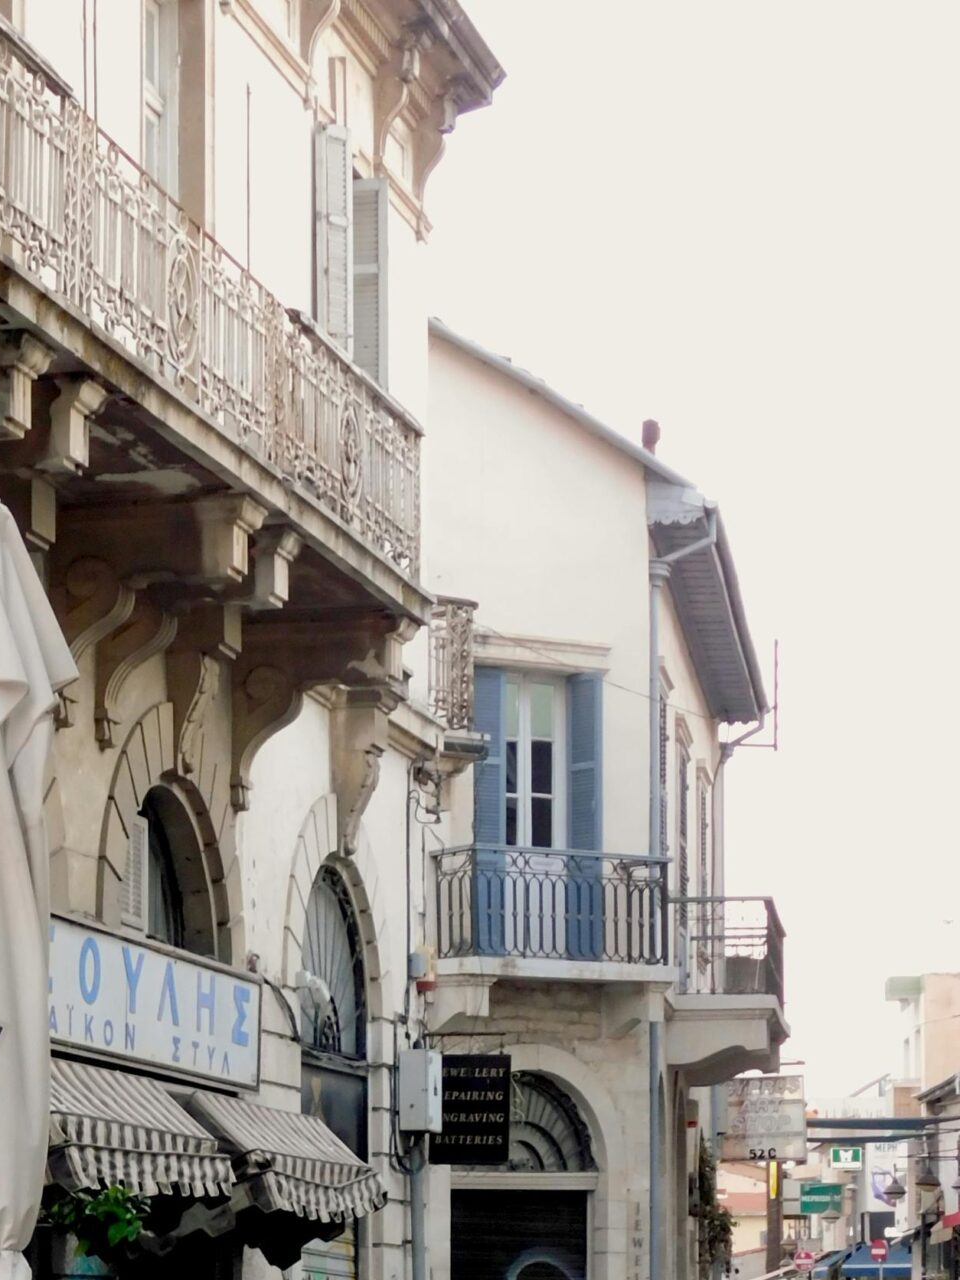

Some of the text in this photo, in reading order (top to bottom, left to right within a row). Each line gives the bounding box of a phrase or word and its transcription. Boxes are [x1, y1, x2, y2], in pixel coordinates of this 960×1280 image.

[49, 924, 251, 1047] ΟΥΛΗΣ
[739, 1097, 784, 1114] ART
[730, 1114, 792, 1132] SHOP
[435, 1135, 503, 1144] BATTERIES
[749, 1148, 765, 1160] 52
